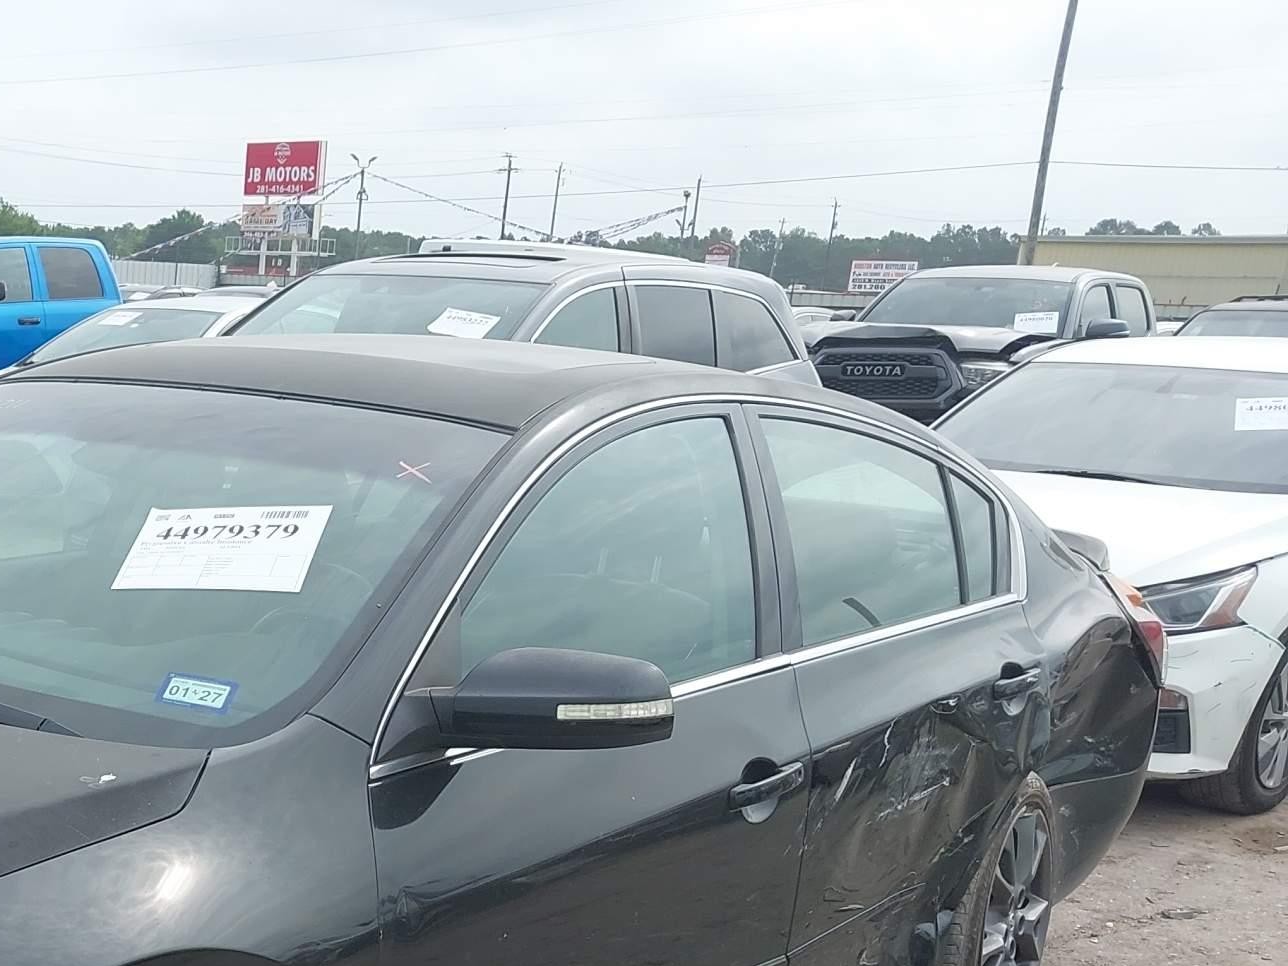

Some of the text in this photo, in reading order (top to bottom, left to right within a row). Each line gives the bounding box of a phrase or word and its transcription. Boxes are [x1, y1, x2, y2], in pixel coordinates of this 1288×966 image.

[247, 165, 316, 183] JB MOTORS
[845, 365, 902, 376] TOYOTA
[156, 524, 300, 540] 44979379
